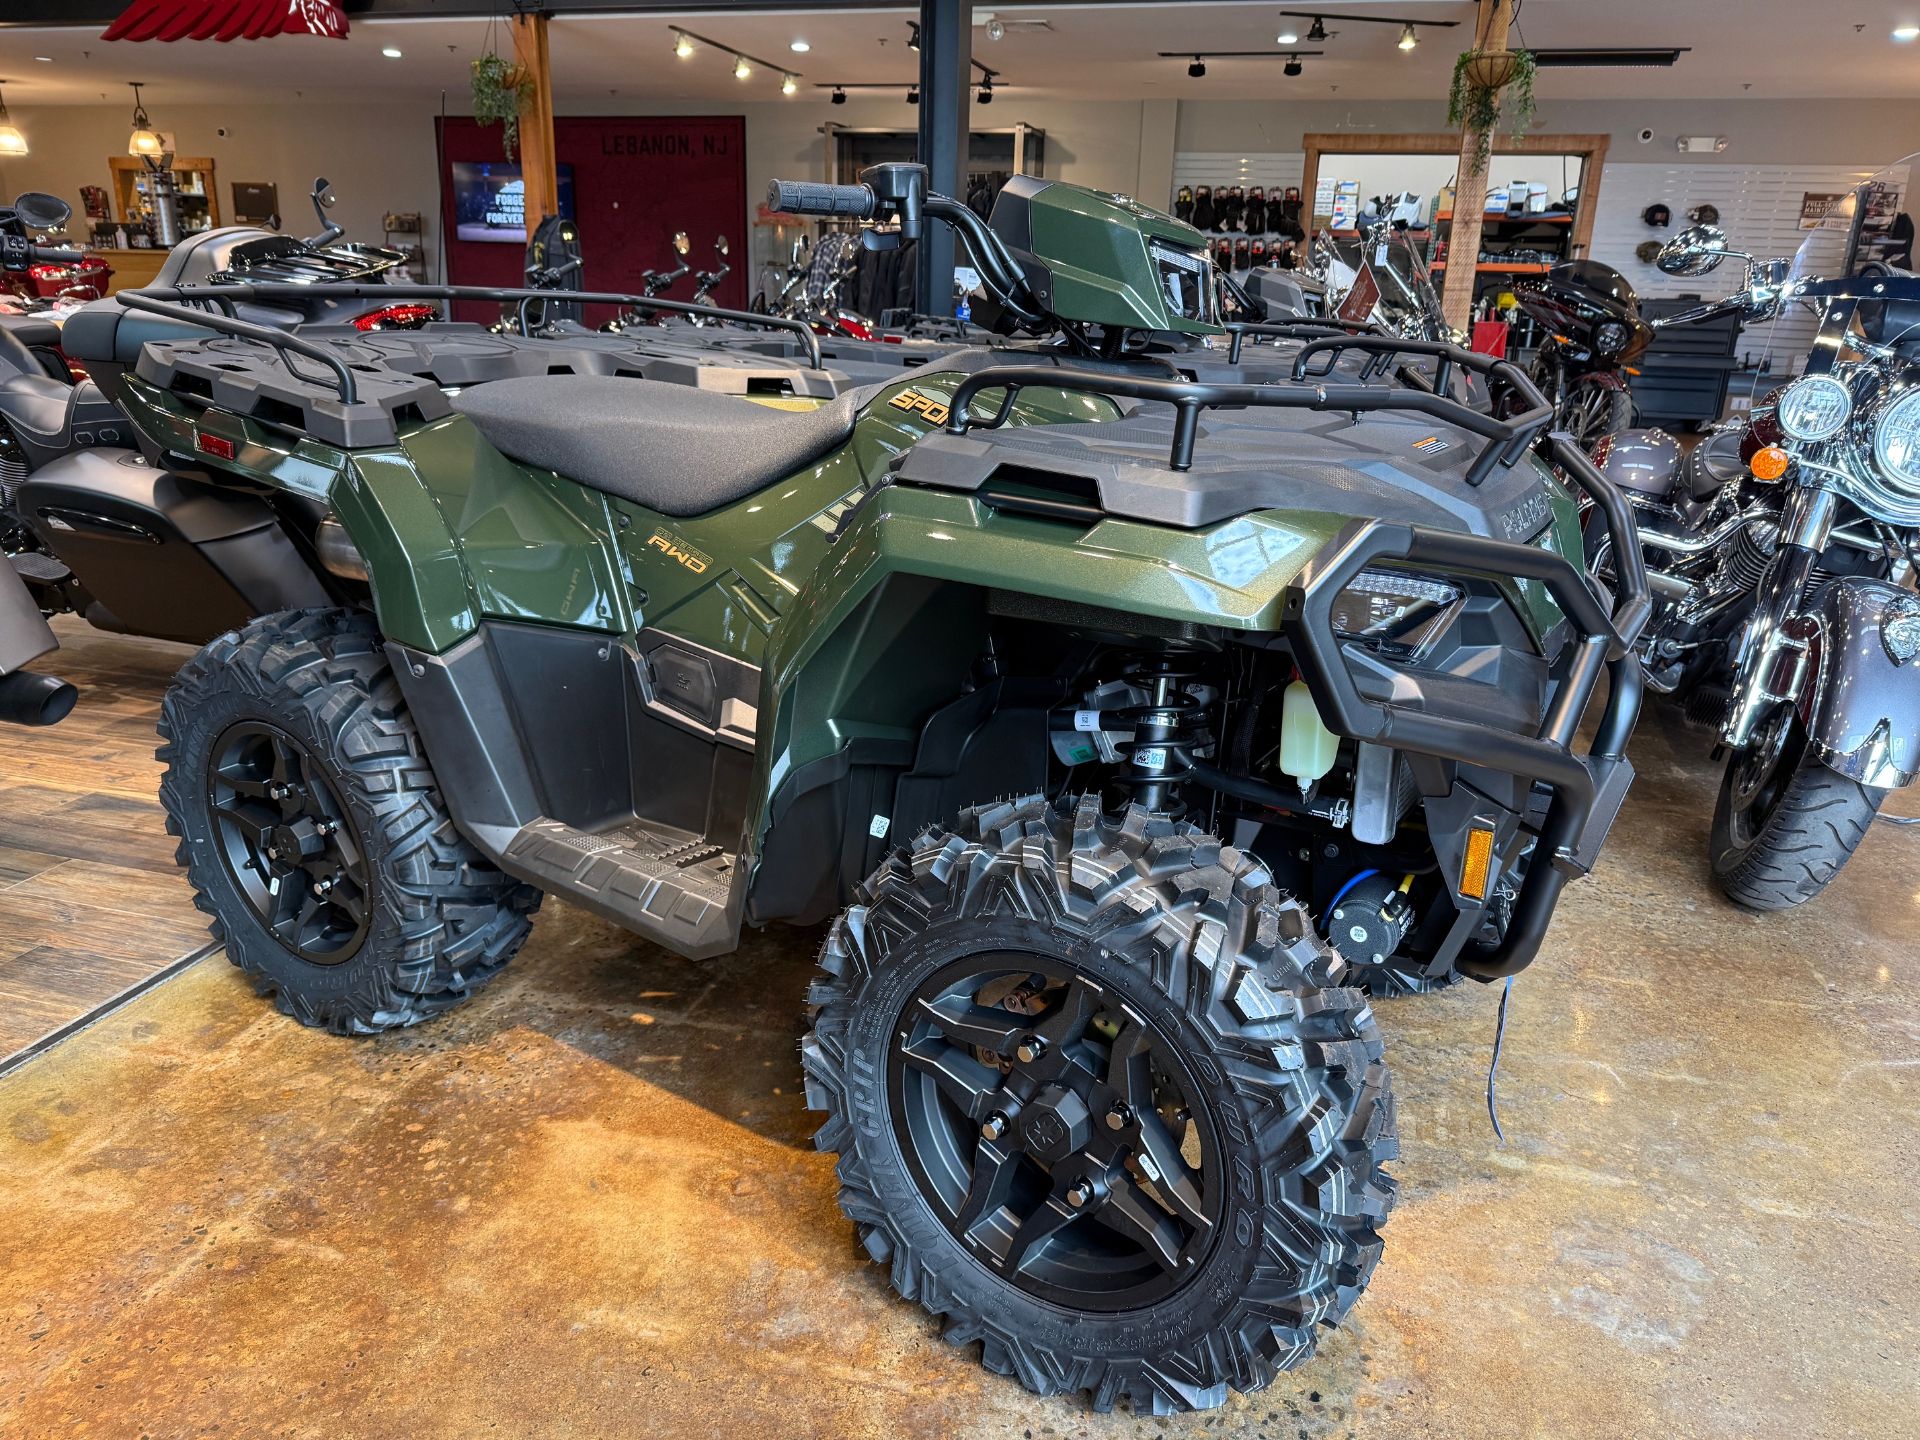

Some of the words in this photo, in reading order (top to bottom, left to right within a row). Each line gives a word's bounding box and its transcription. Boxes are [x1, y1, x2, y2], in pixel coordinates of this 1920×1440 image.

[601, 134, 696, 159] LEBANON,
[703, 134, 728, 156] NJ
[486, 212, 524, 224] FOREVER
[887, 388, 950, 428] SPO
[647, 535, 707, 574] AWD
[852, 1048, 882, 1138] GRIP
[1187, 1048, 1256, 1249] DURO
